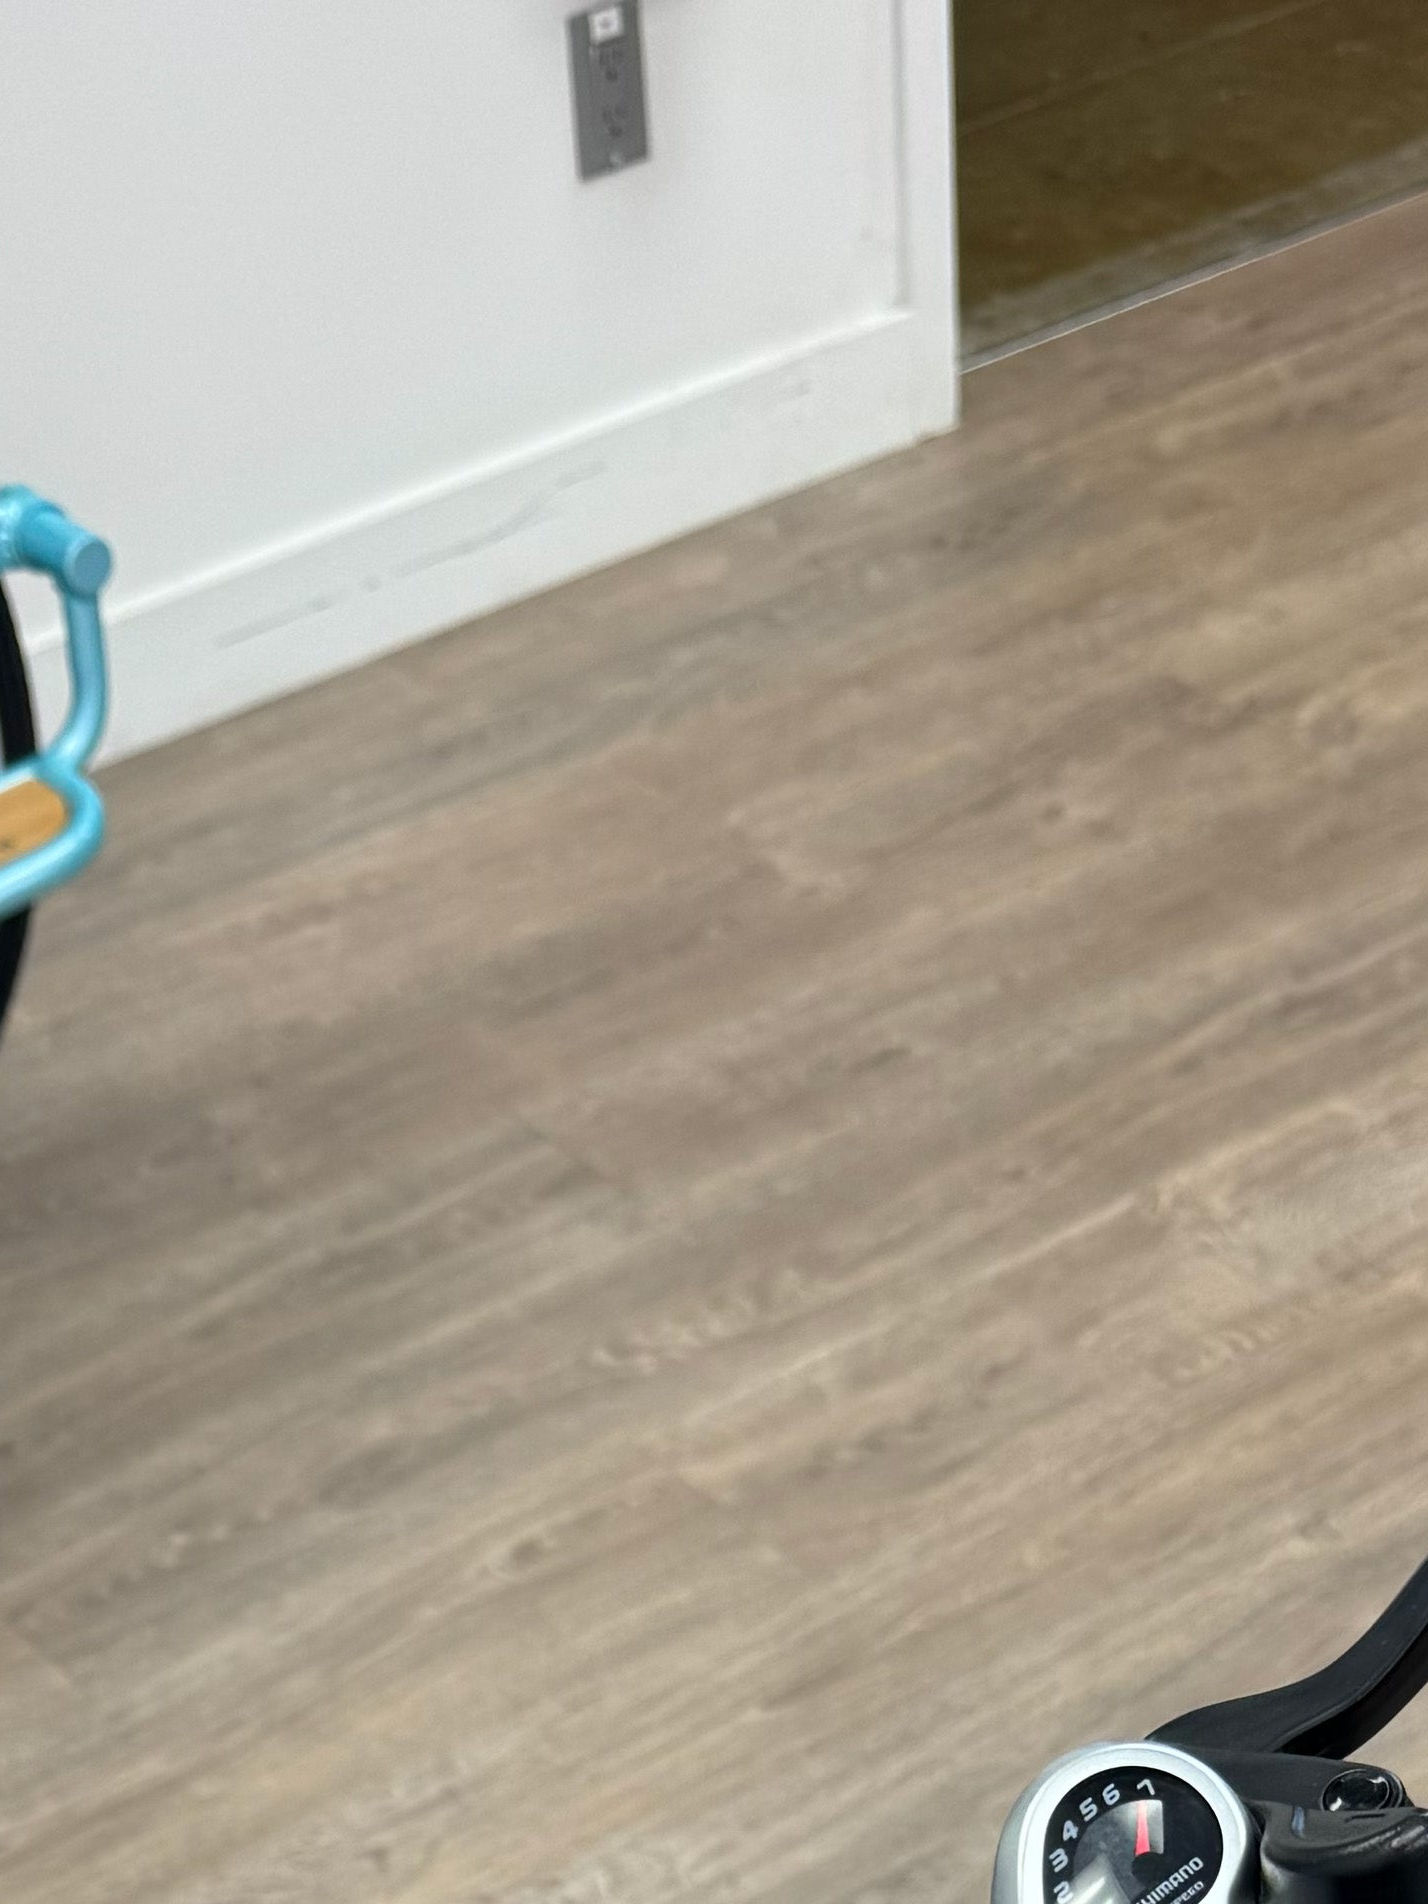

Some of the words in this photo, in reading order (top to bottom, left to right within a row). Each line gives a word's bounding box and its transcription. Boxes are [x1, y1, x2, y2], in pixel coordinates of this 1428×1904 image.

[1101, 1783, 1121, 1806] 6
[1136, 1778, 1156, 1796] 7
[1079, 1797, 1098, 1822] 5
[1062, 1819, 1079, 1842] 4
[1049, 1848, 1069, 1873] 3
[1053, 1880, 1074, 1904] 2
